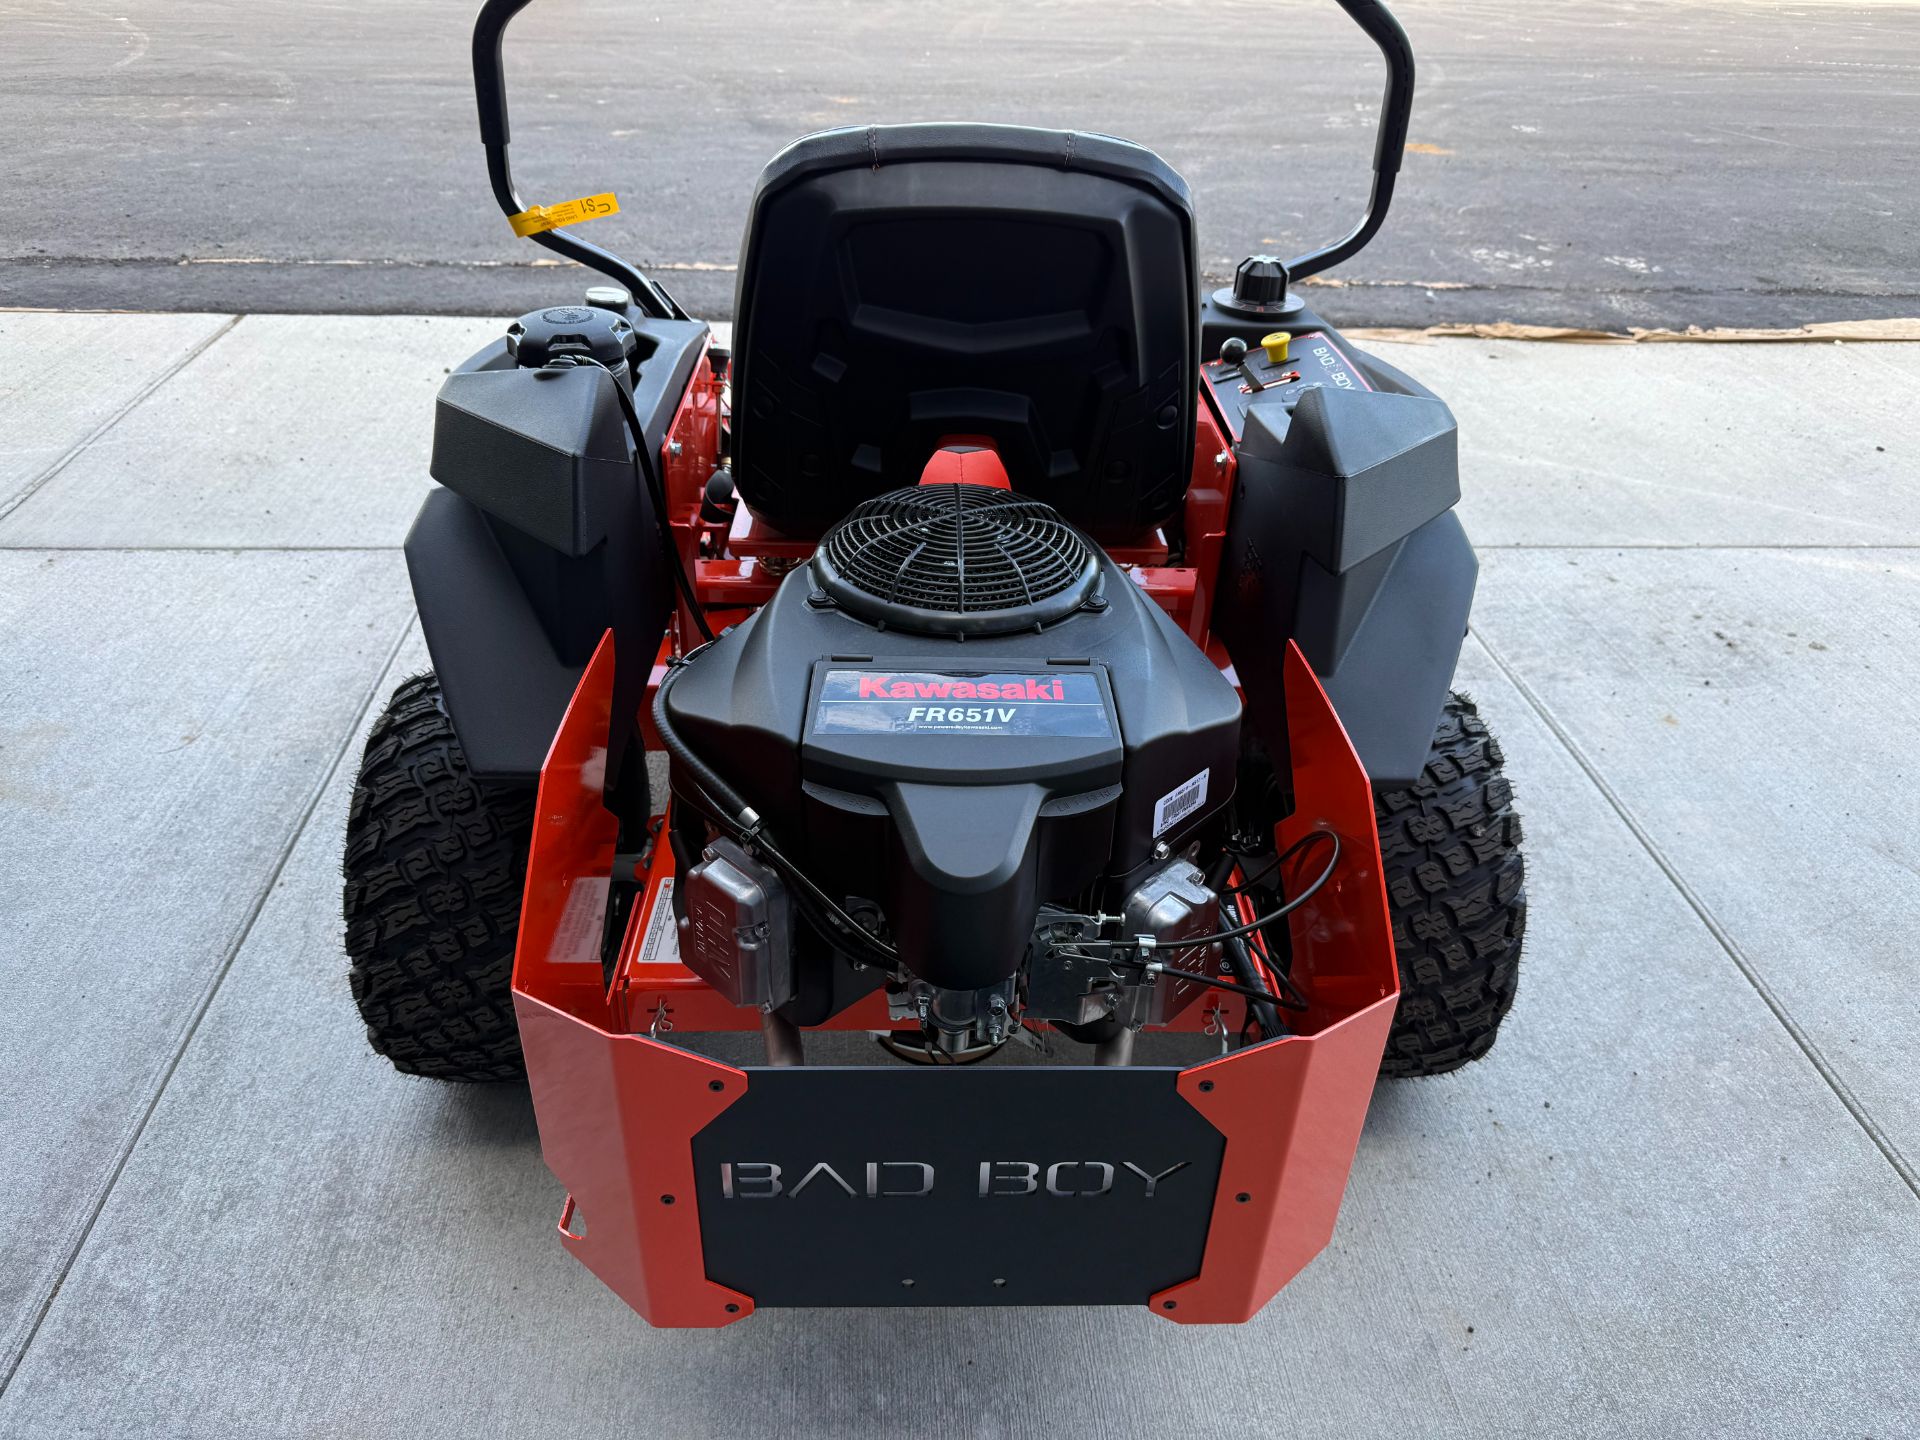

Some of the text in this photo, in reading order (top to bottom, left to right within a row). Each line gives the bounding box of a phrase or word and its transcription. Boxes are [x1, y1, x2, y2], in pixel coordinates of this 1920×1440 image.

[1313, 347, 1356, 390] BAD BOY
[859, 677, 1064, 700] Kawasaki
[907, 707, 1016, 723] FR651V
[721, 1161, 1193, 1199] BAD BOY
